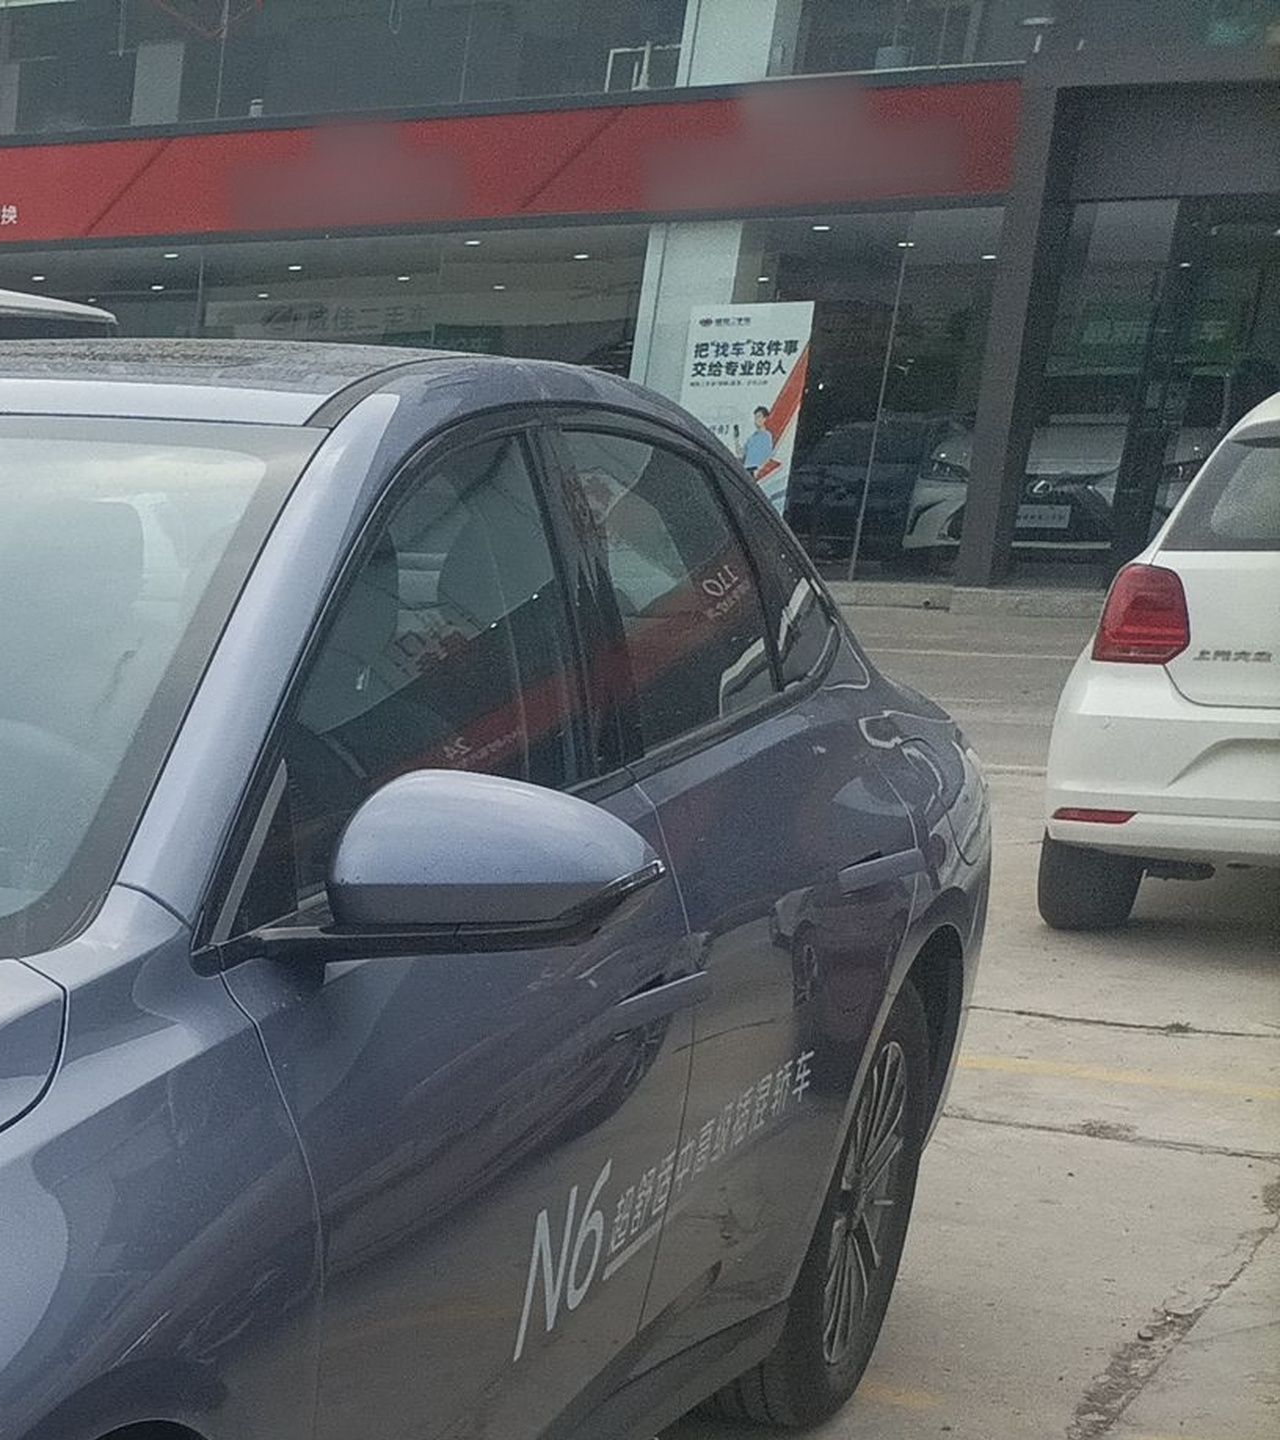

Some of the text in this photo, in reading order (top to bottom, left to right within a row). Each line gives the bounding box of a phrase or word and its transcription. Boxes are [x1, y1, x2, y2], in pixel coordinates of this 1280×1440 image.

[690, 359, 787, 378] 交给专业的人
[513, 1158, 612, 1363] N6
